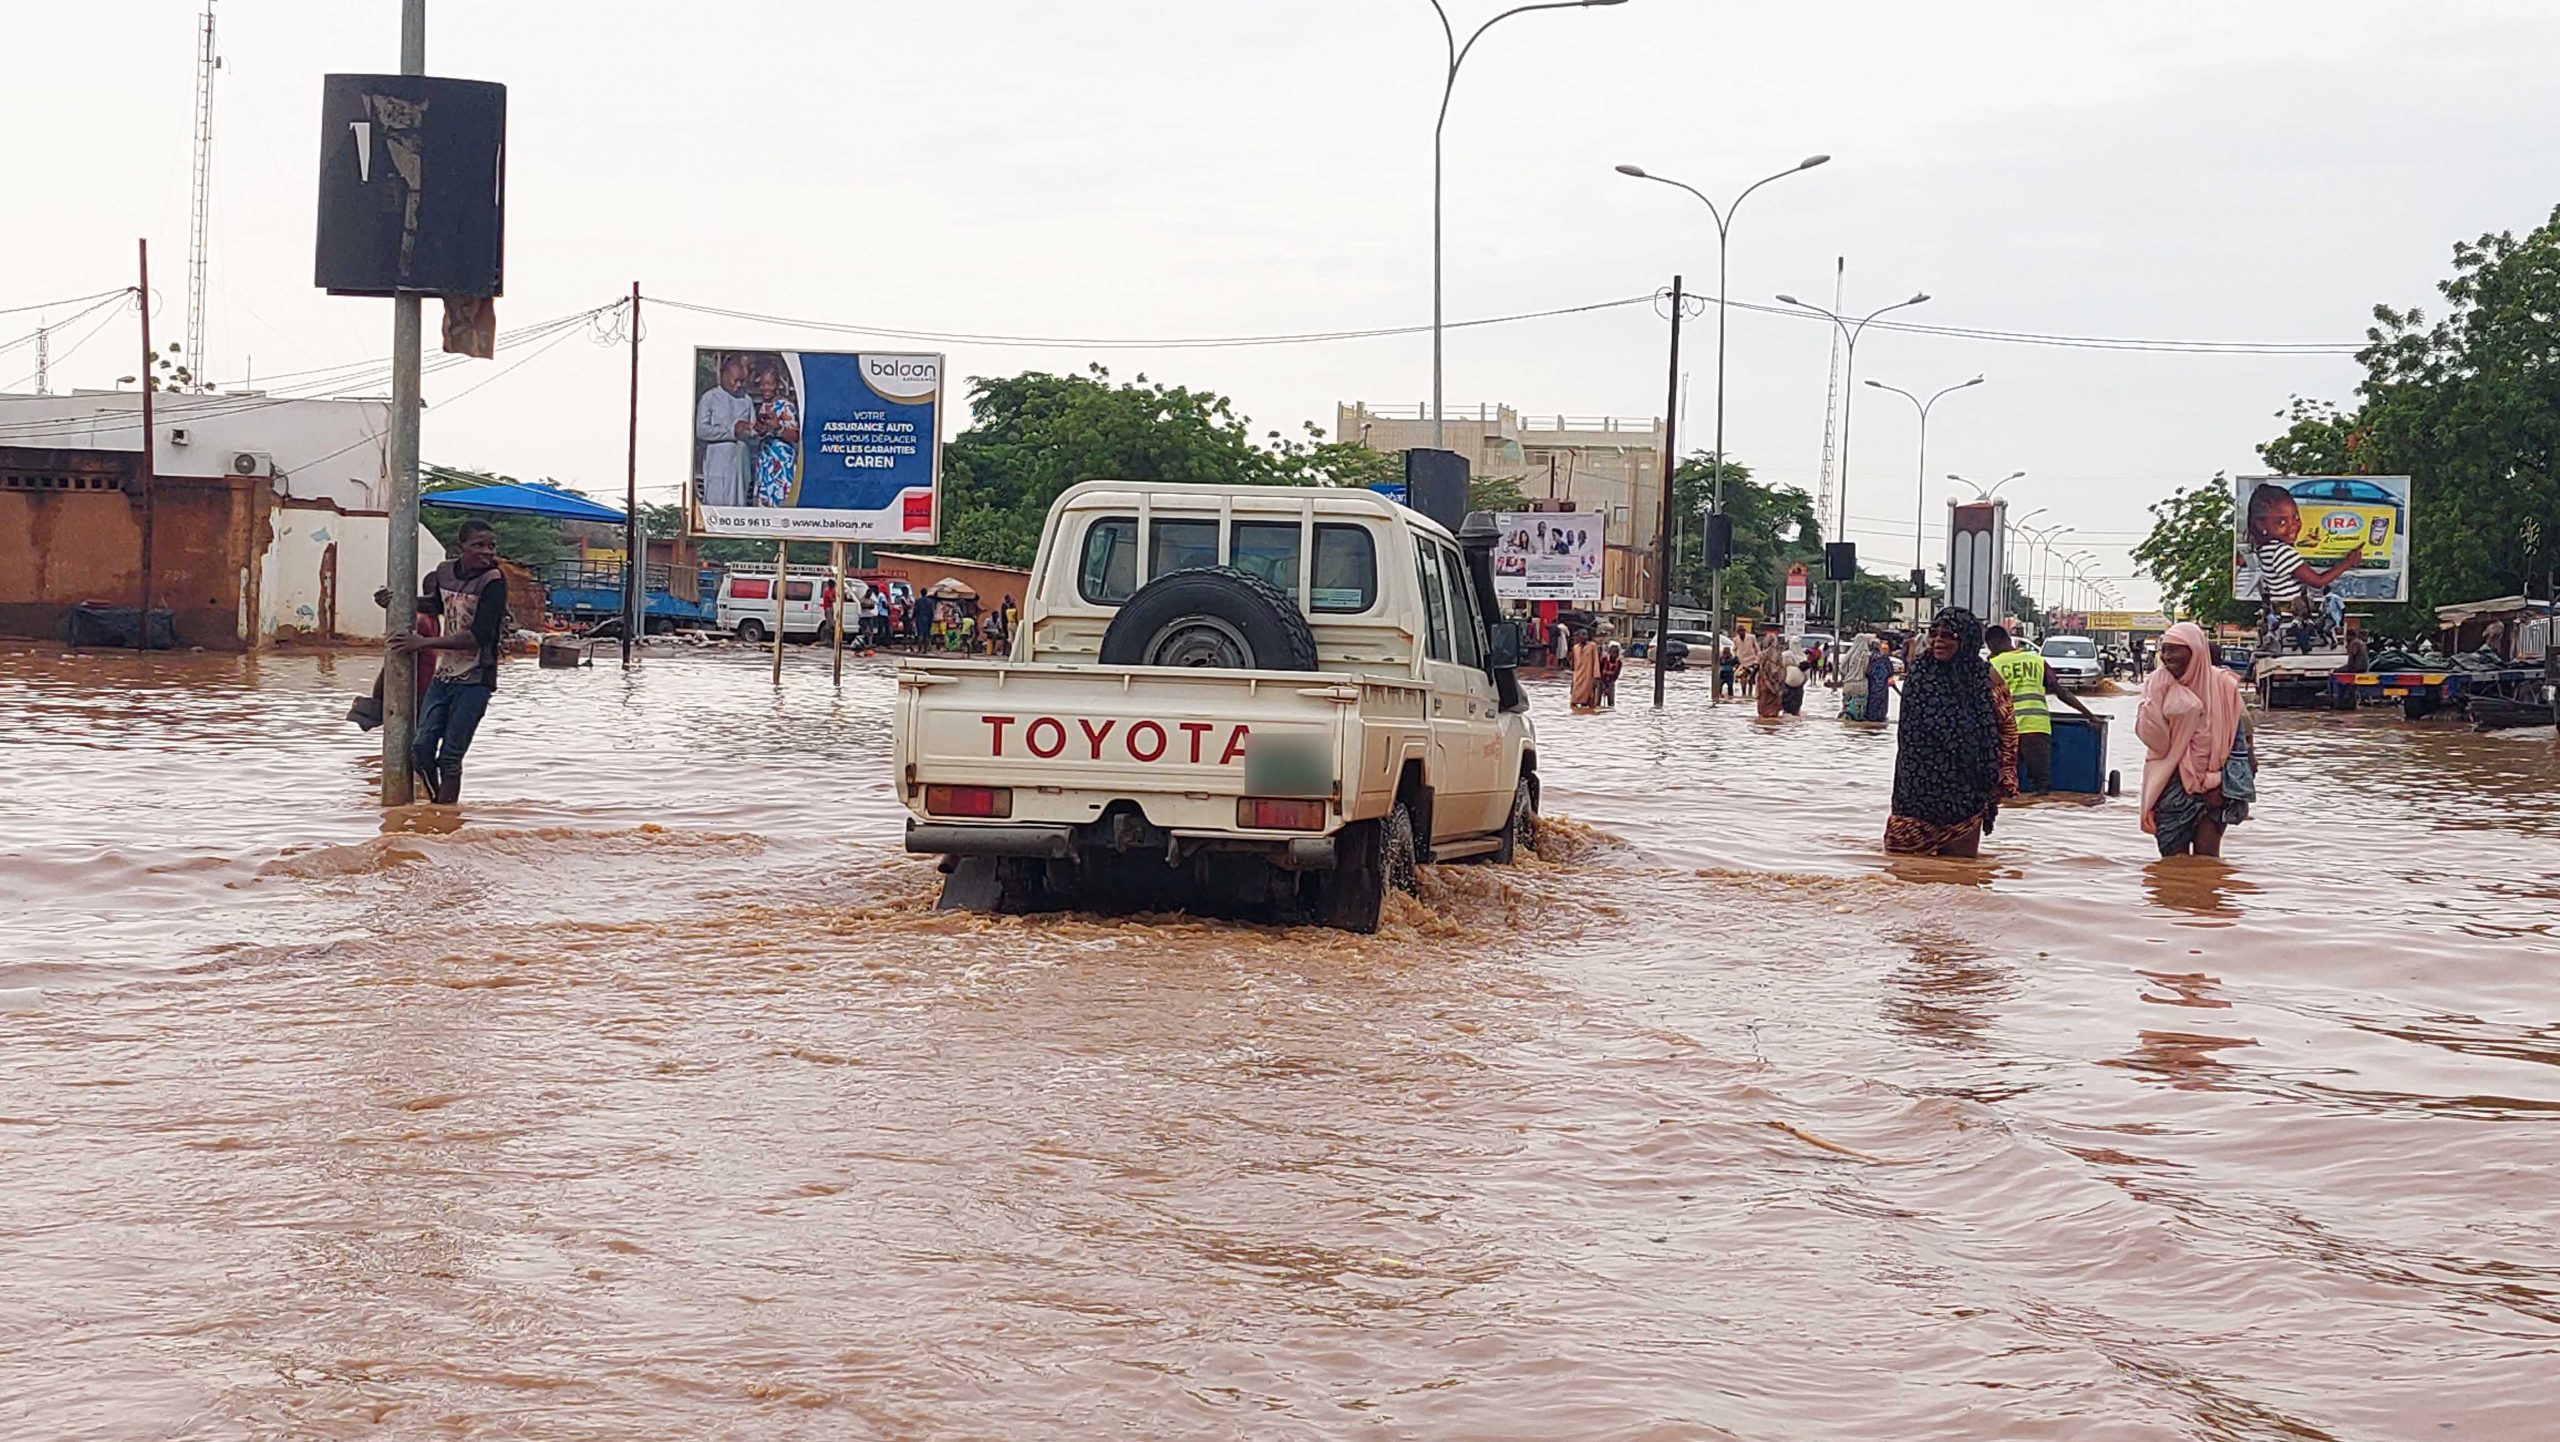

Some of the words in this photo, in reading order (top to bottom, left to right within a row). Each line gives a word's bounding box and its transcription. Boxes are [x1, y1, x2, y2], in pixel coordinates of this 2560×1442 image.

[871, 359, 936, 377] baloon
[853, 411, 886, 420] VOTRE
[823, 422, 884, 431] ASSURANCE
[886, 423, 914, 432] AUTO
[821, 434, 845, 442] SANS
[845, 434, 870, 443] VOUS
[820, 445, 845, 453] AVEC
[846, 445, 863, 453] LES
[844, 455, 894, 468] CAREN
[2326, 517, 2358, 528] IRA
[981, 715, 1252, 765] TOYOTA
